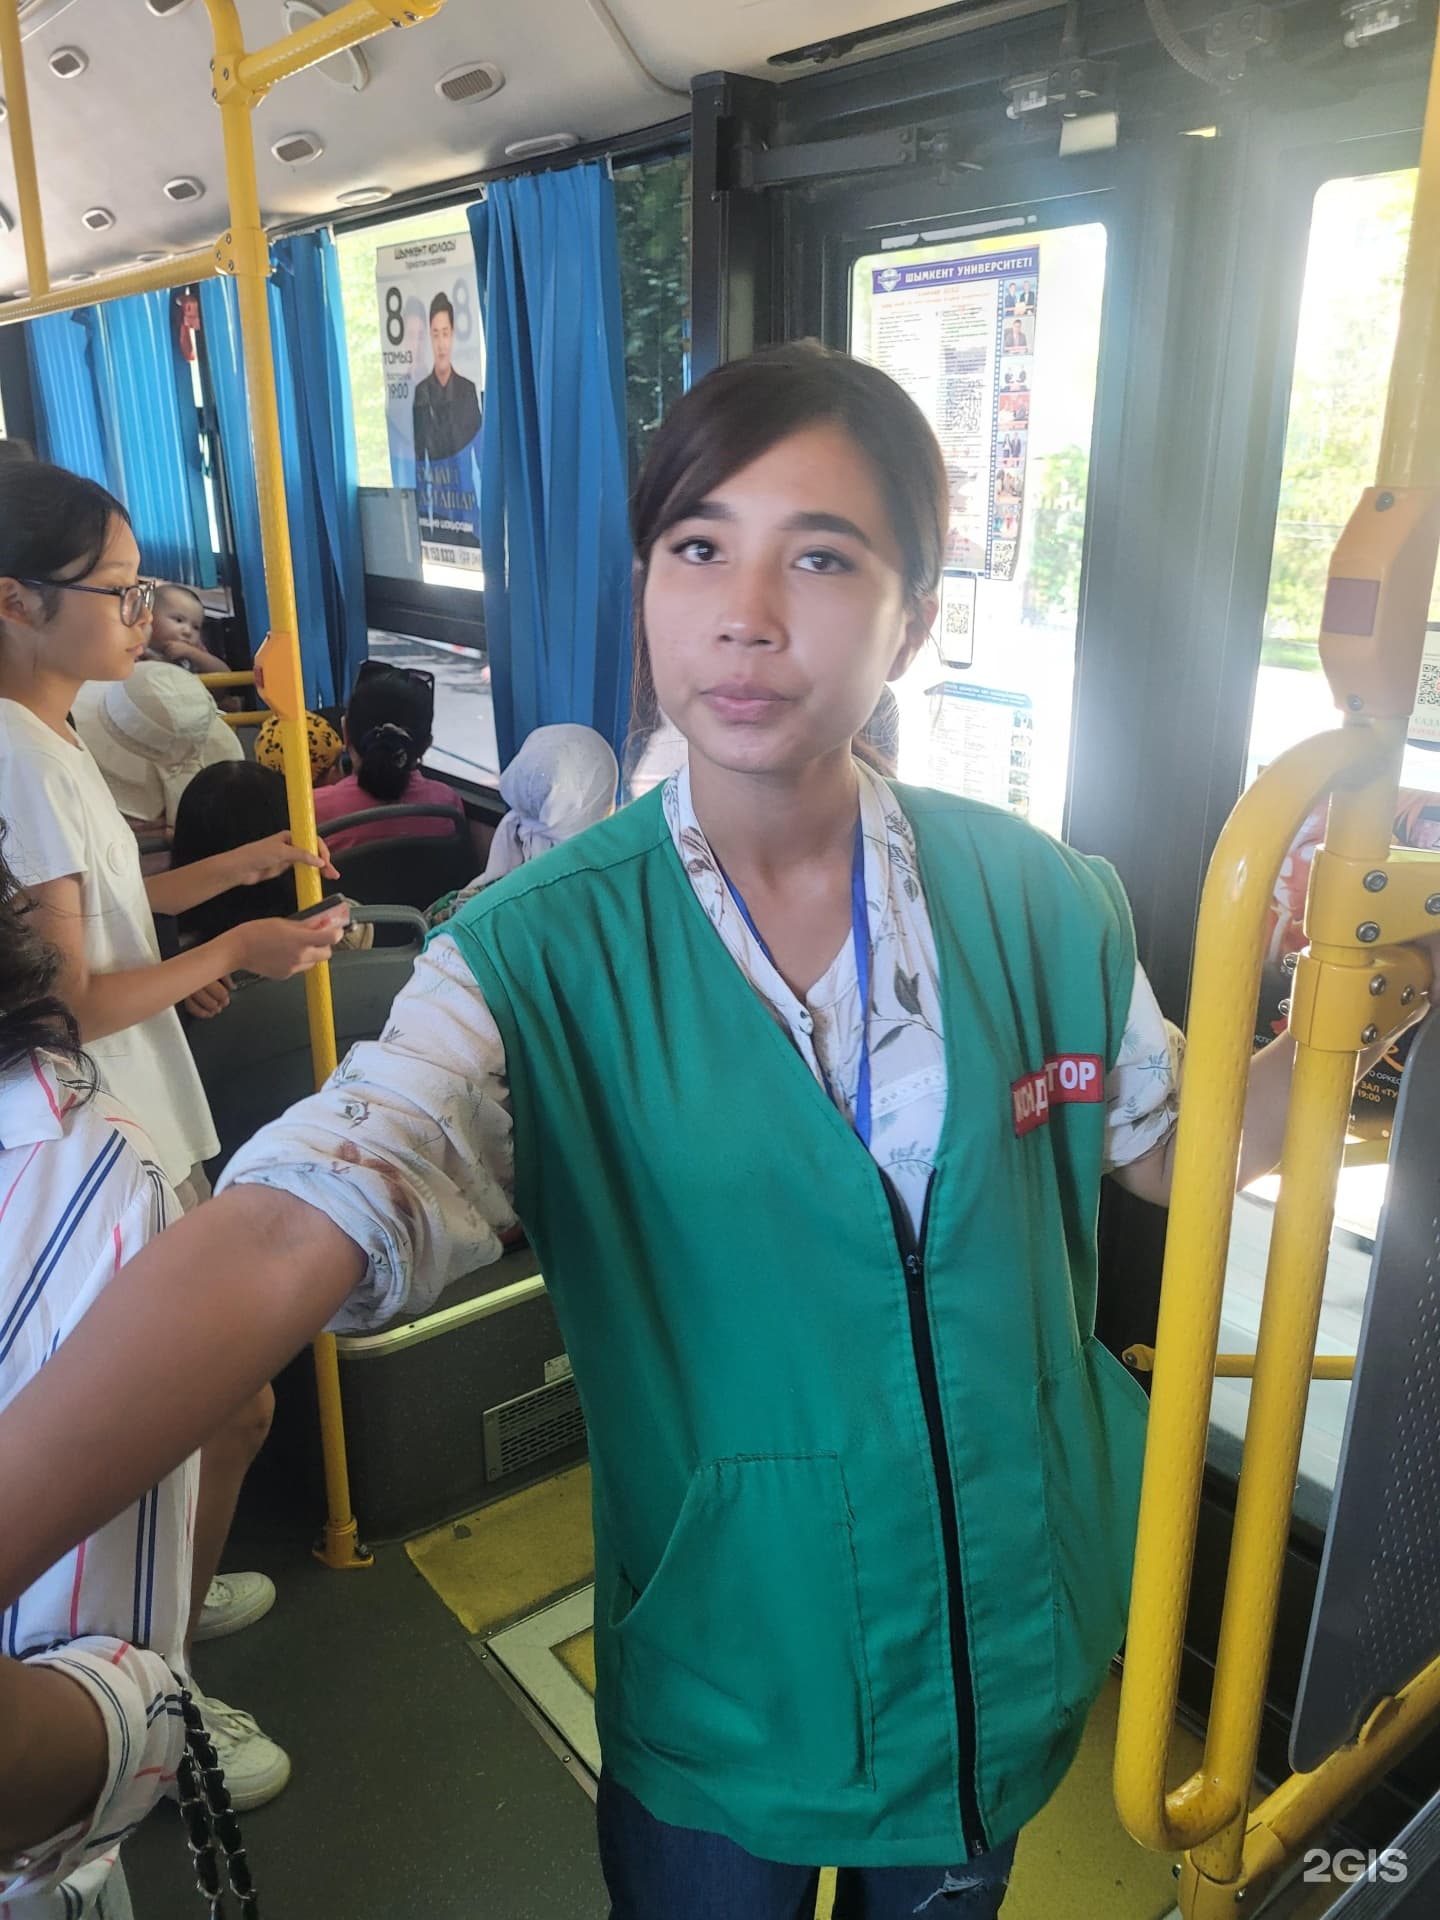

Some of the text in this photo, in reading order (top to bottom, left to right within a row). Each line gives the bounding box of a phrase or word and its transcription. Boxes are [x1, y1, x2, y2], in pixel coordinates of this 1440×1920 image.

[905, 266, 954, 283] ШЫМКЕНТ
[957, 256, 1032, 276] УНИВЕРСИТЕТІ
[385, 286, 404, 346] 8
[1358, 1089, 1381, 1103] 19:00
[1360, 1080, 1380, 1093] ЗАЛ
